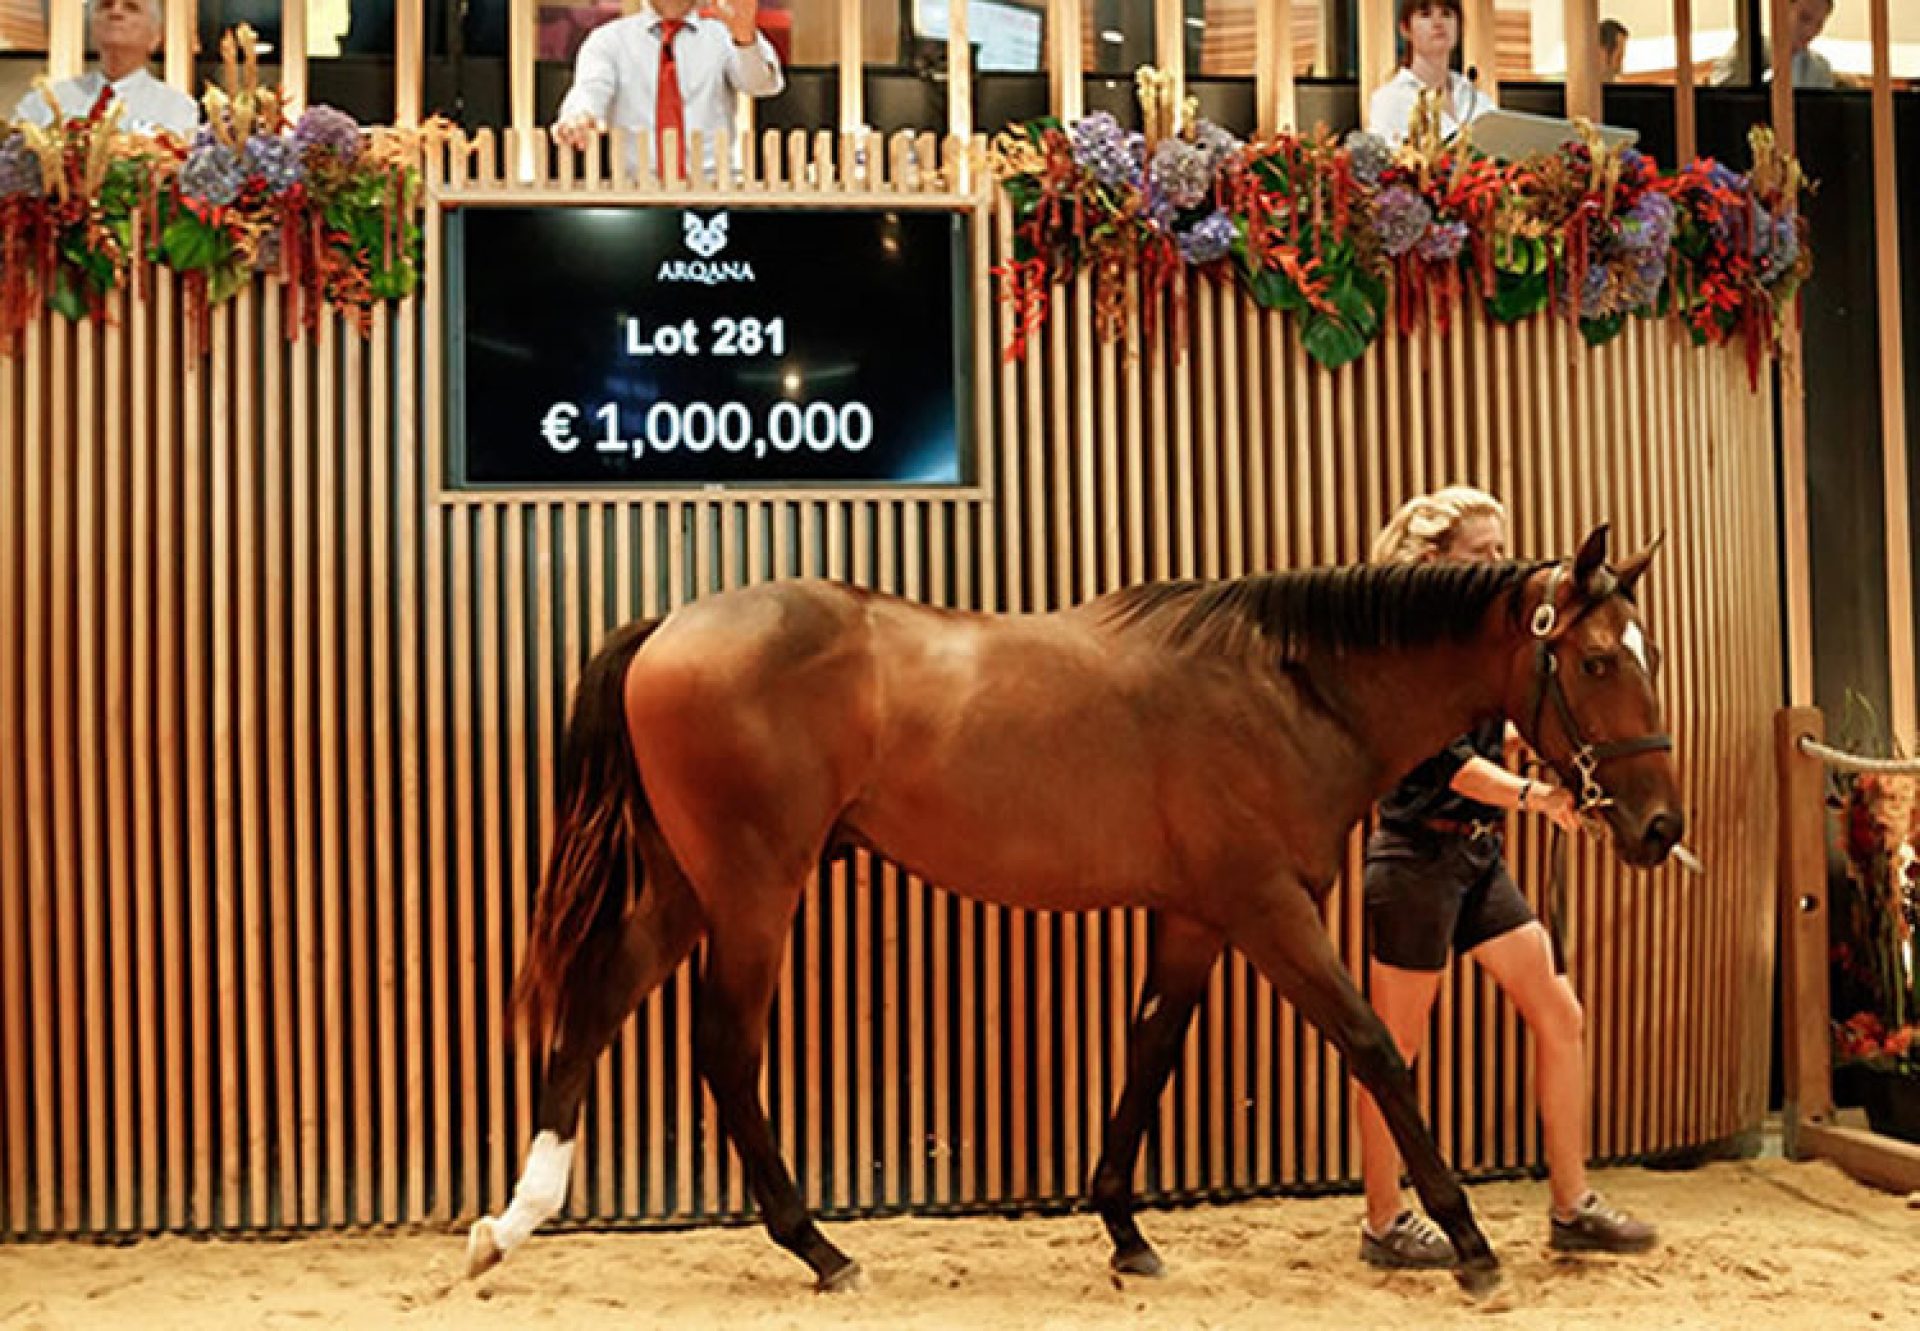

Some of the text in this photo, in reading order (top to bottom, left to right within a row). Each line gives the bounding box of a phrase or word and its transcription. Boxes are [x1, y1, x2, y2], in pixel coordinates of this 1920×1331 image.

[657, 259, 756, 285] ARQANA
[626, 317, 785, 355] Lot 281
[541, 401, 873, 458] € 1,000,000
